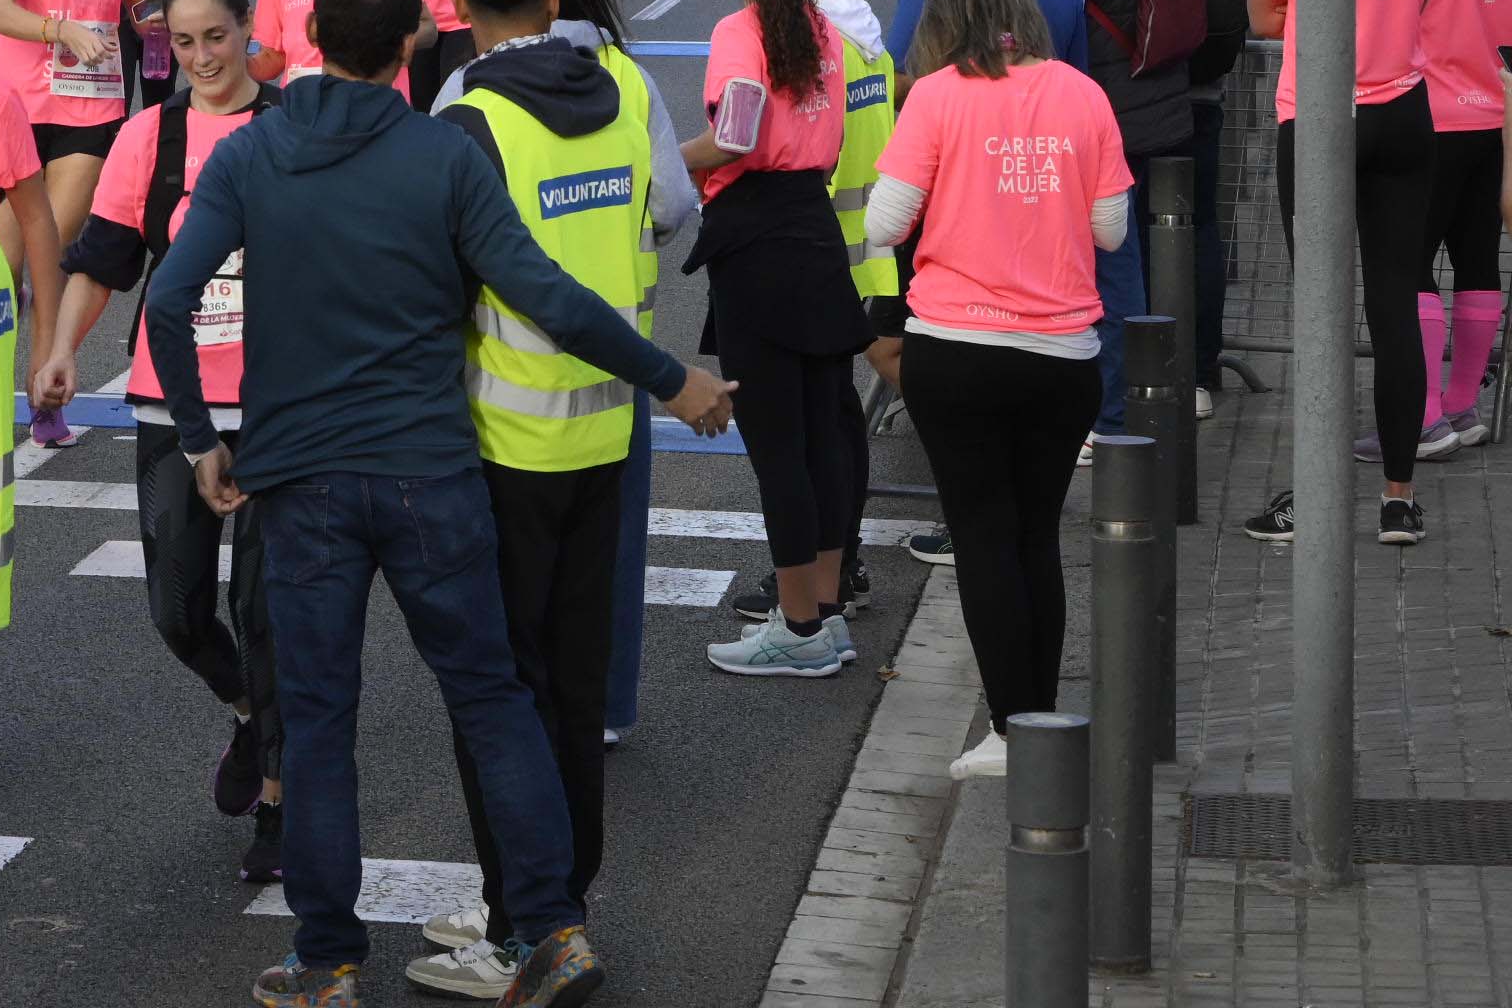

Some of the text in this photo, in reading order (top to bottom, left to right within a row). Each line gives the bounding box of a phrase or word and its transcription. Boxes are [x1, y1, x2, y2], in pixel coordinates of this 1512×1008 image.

[984, 136, 1074, 156] CARRERA
[1001, 155, 1057, 175] DE LA
[997, 174, 1061, 193] MUJER
[541, 178, 631, 210] VOLUNTARIS
[206, 281, 232, 297] 16
[210, 315, 220, 323] LA
[966, 303, 1020, 322] OYSHO
